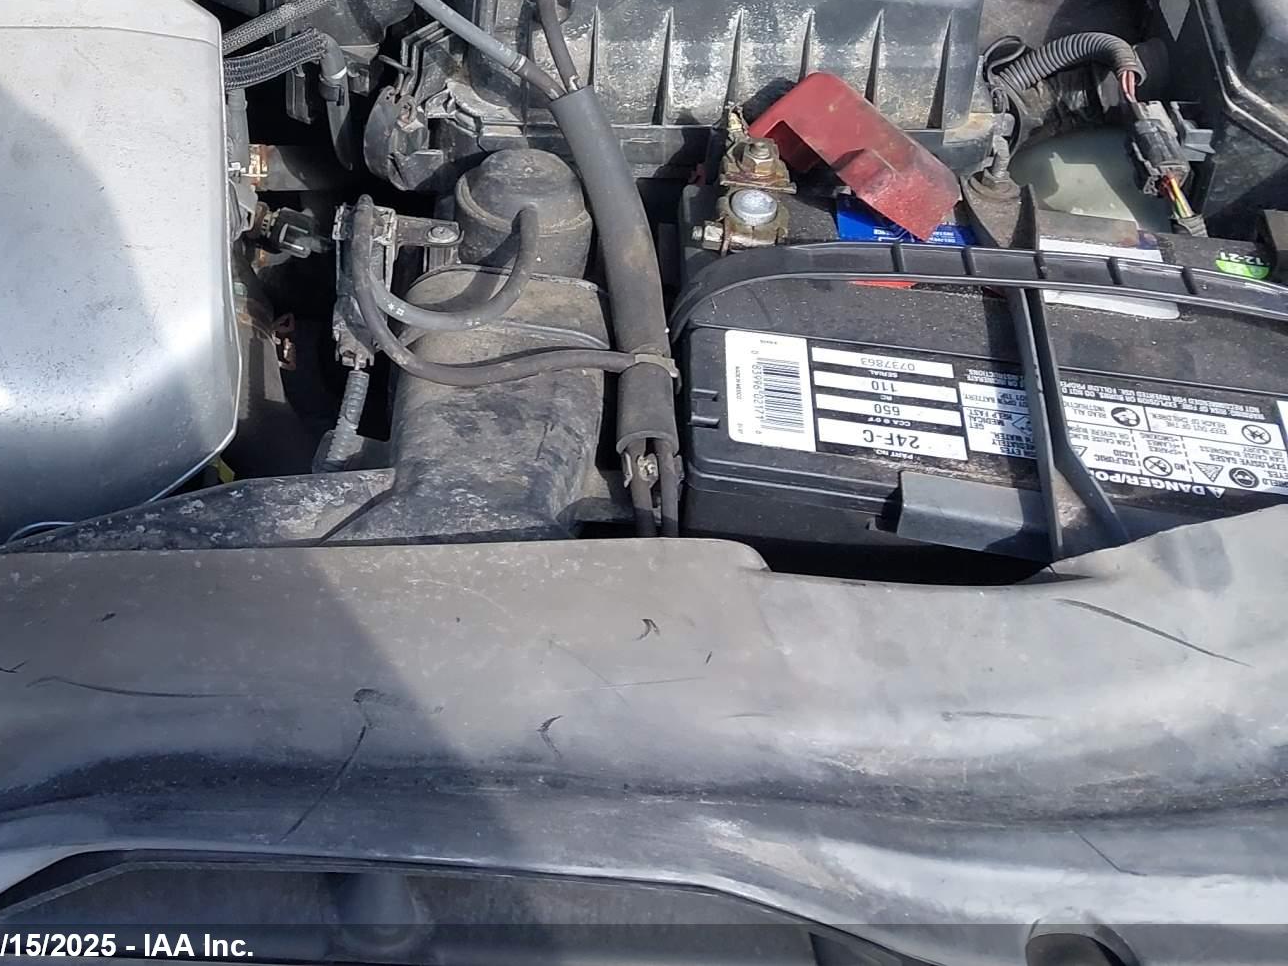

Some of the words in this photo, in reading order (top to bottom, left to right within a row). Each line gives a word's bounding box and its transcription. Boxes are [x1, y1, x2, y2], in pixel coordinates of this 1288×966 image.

[1220, 252, 1264, 266] 12-21
[860, 358, 915, 371] 0737863
[868, 370, 899, 378] SERIAL
[871, 380, 897, 393] 110
[873, 403, 901, 416] 650
[892, 419, 911, 427] CCA
[863, 430, 920, 449] 24F-C
[890, 451, 913, 460] PART
[1091, 471, 1206, 495] DANGER/PO
